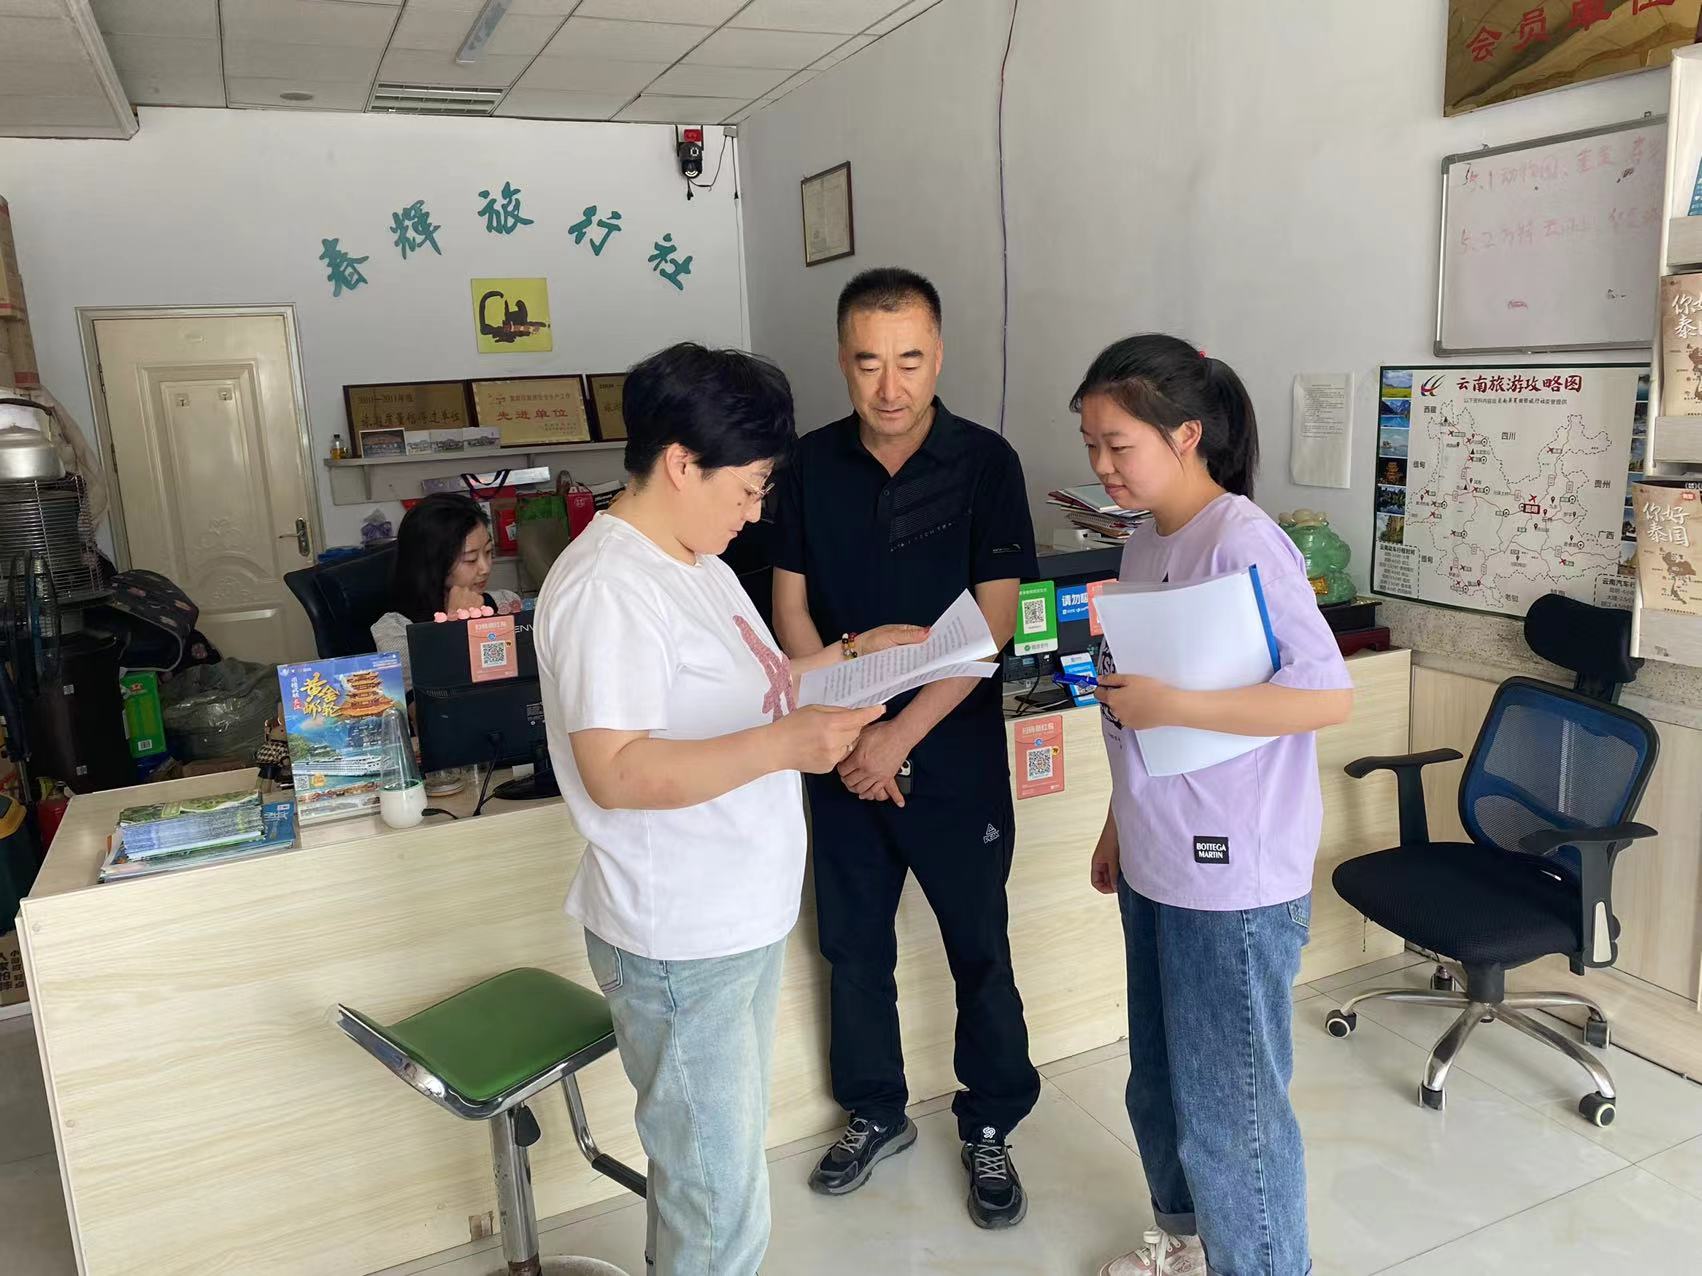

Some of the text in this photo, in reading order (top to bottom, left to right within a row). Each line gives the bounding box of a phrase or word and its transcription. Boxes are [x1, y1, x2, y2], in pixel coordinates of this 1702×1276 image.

[1465, 0, 1675, 62] 会员单
[1674, 316, 1702, 339] 泰
[1456, 375, 1583, 393] 云南旅游攻略图
[496, 408, 569, 421] 先进单位
[1501, 431, 1516, 441] 四川
[1594, 479, 1611, 489] 贵州
[1643, 501, 1690, 525] 你好
[1648, 522, 1690, 547] 泰国
[1196, 842, 1227, 851] BOTTEGA
